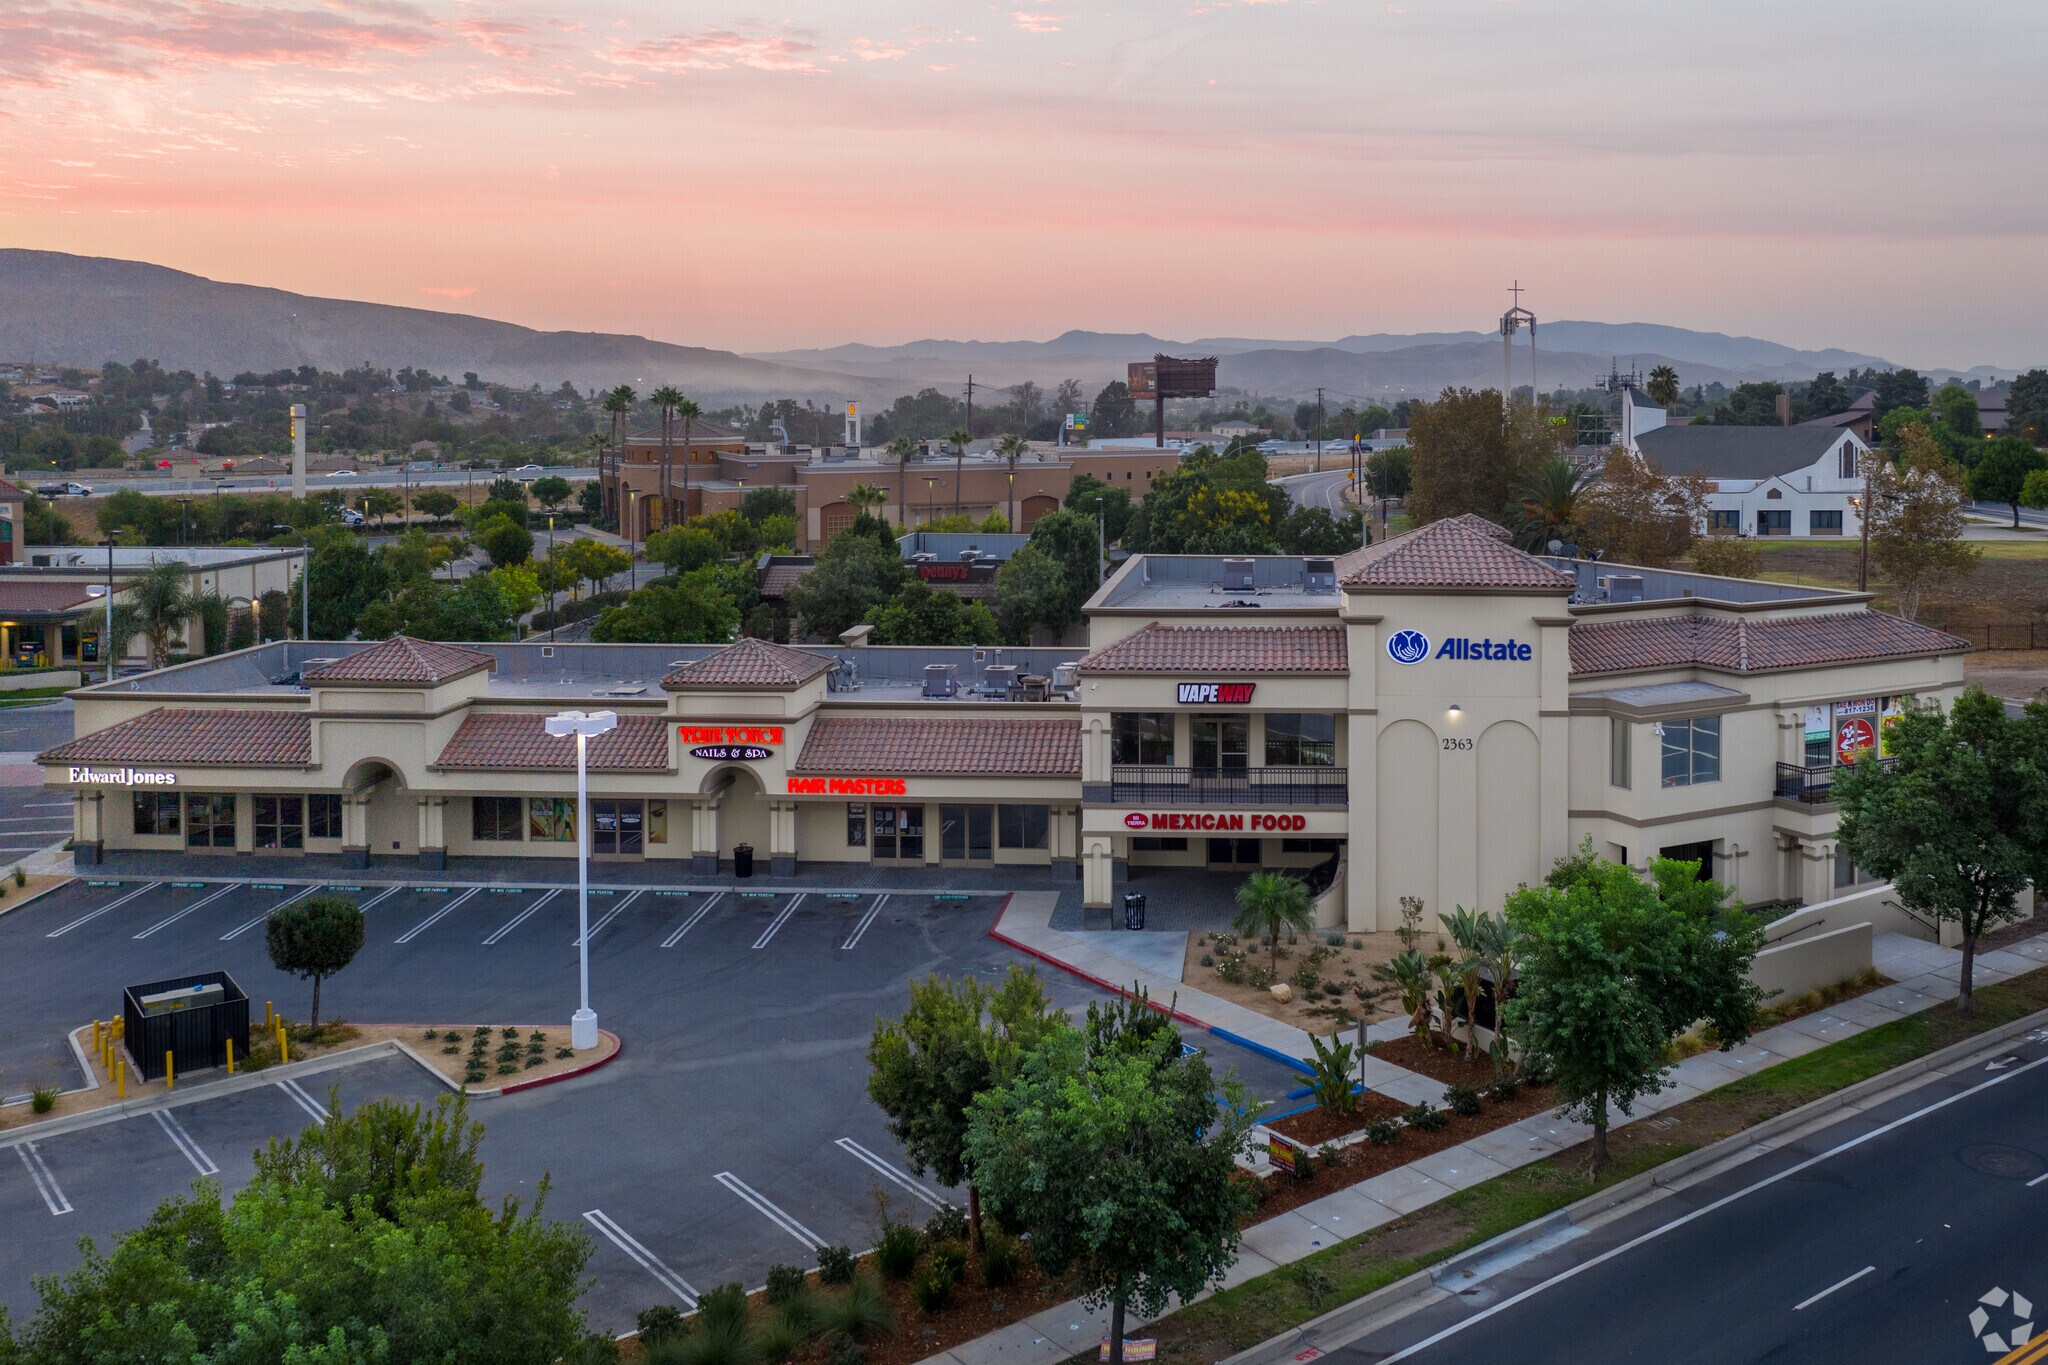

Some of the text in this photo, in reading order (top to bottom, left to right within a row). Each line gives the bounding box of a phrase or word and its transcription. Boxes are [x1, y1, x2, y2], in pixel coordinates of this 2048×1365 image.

[921, 565, 968, 580] Denny's
[1435, 638, 1532, 661] Allstate
[1836, 701, 1847, 709] TAE
[1847, 699, 1866, 708] KWON
[679, 727, 783, 745] TRUE TOUCH
[1442, 738, 1473, 750] 2363
[695, 749, 767, 758] NAILS & SPA
[787, 778, 906, 795] HAIR MASTERS
[1152, 813, 1306, 831] MEXICAN FOOD
